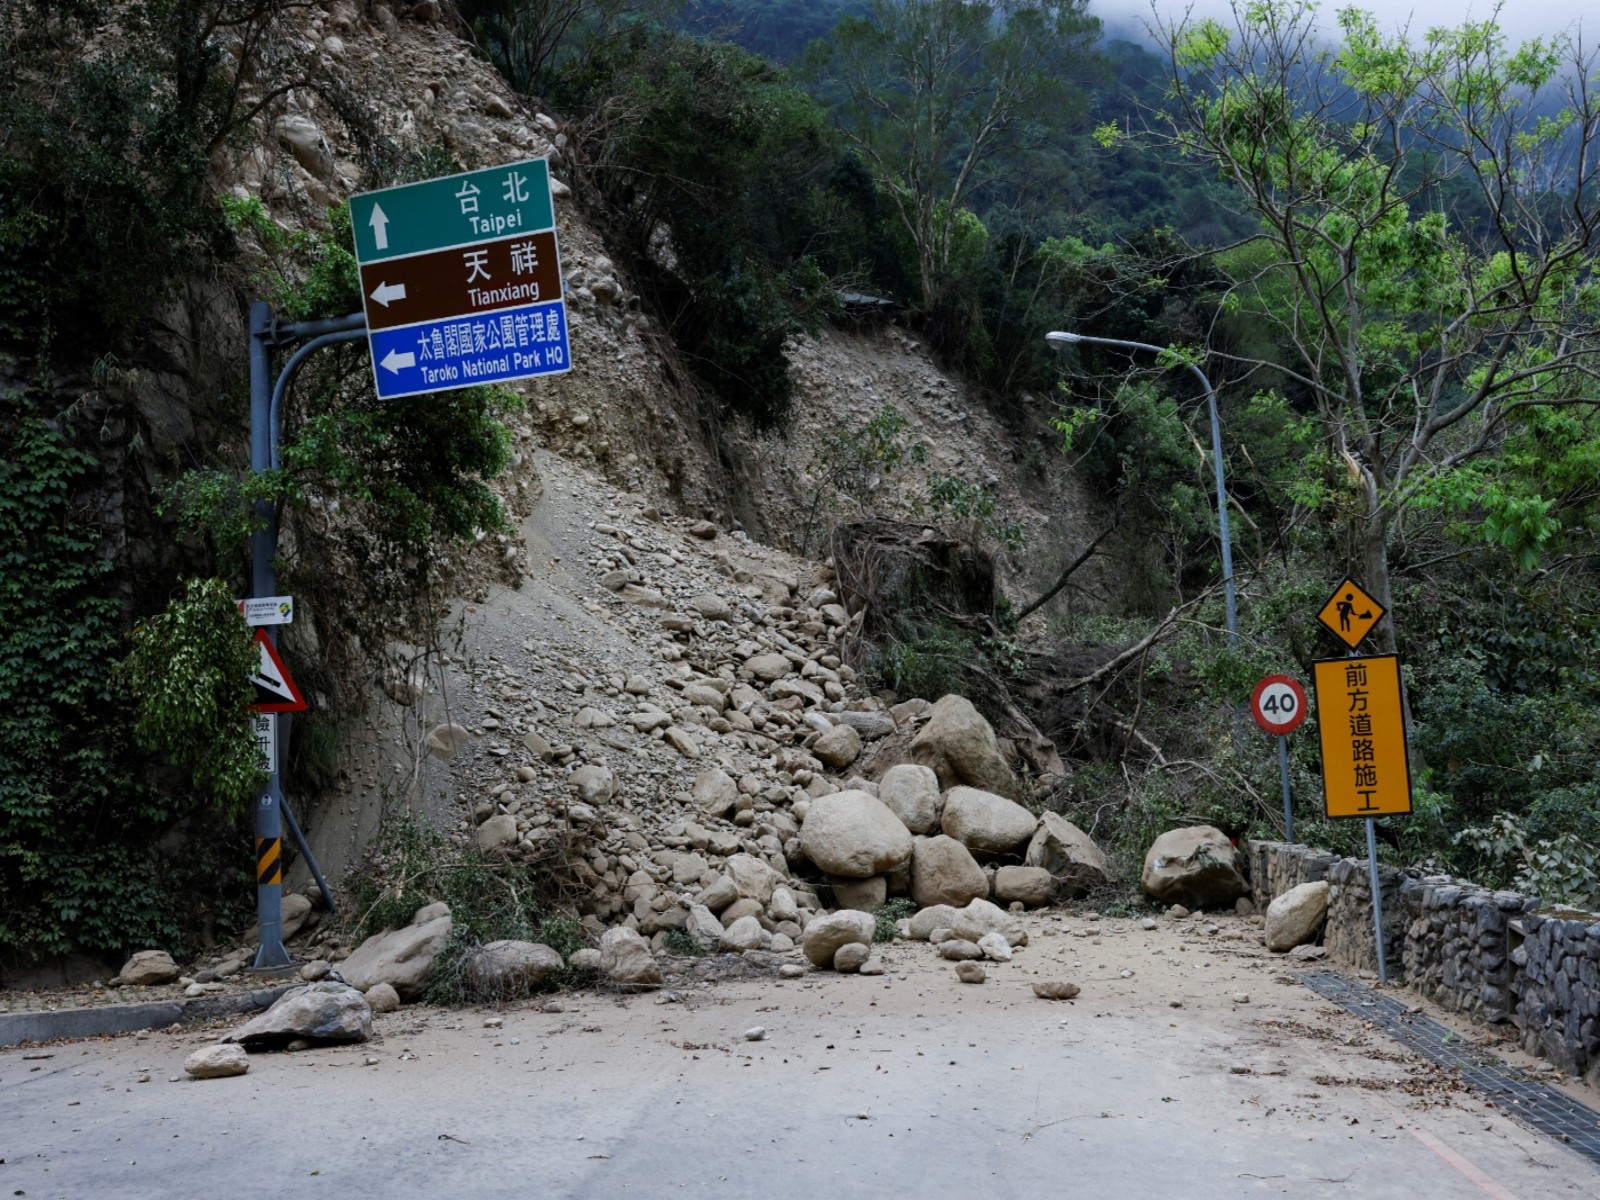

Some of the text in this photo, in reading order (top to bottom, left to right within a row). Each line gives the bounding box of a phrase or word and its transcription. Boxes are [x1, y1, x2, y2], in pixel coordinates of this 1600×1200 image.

[455, 171, 530, 215] 台北
[469, 209, 522, 234] Taipei
[463, 240, 539, 284] 天祥
[467, 280, 539, 307] Tianxiang
[417, 308, 561, 362] 太魯閣國家公園管理處
[420, 347, 564, 384] Taroko National Park HQ
[1263, 693, 1295, 715] 40
[1344, 663, 1380, 812] 前方道路施工
